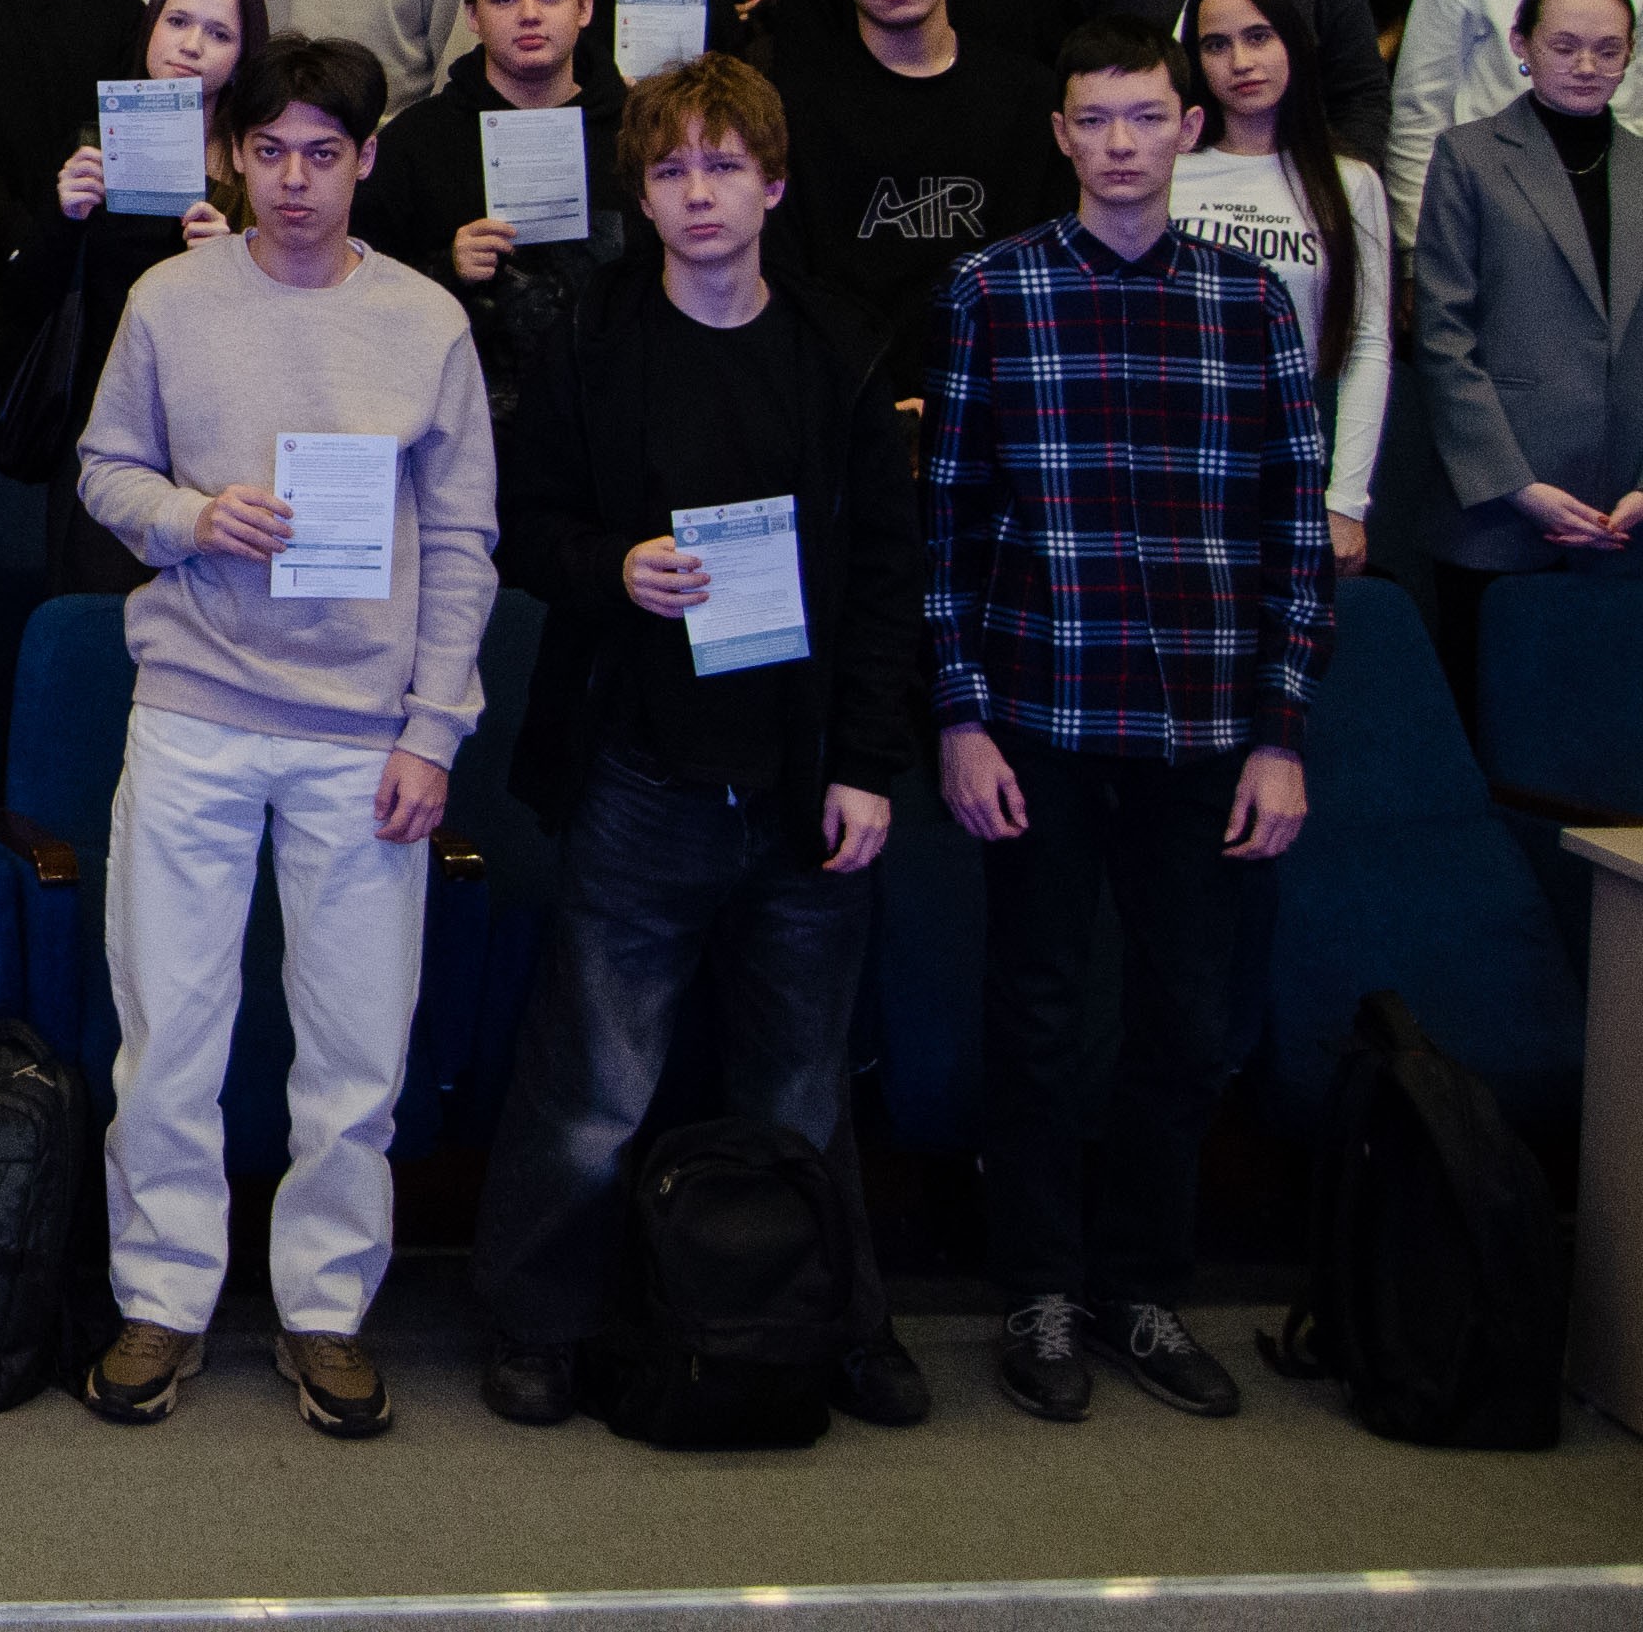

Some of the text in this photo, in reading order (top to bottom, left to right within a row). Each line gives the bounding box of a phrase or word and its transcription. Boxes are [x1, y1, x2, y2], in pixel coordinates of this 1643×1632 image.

[857, 176, 985, 239] AIR
[1199, 203, 1257, 212] A WORLD
[1233, 213, 1291, 224] WITHOUT
